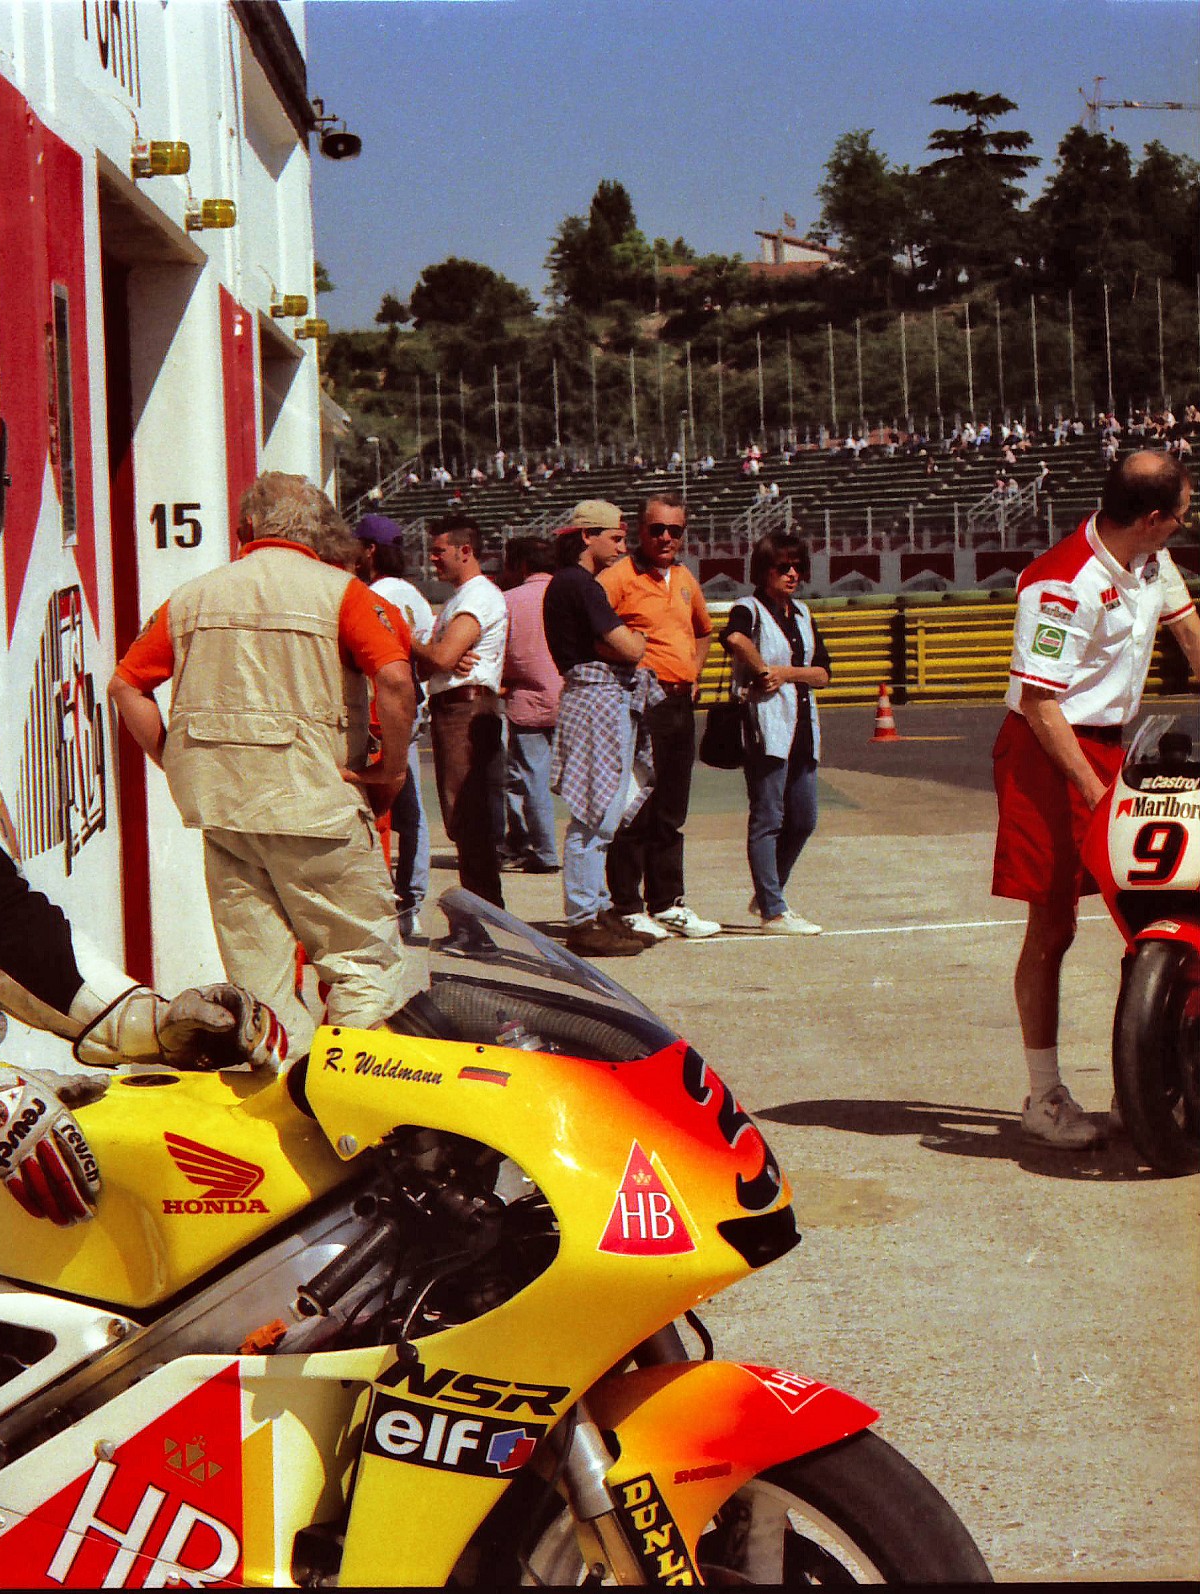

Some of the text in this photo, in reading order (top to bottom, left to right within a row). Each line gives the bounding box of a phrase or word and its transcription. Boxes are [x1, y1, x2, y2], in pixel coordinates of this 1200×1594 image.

[149, 503, 202, 549] 15
[1132, 796, 1200, 819] Marlbor
[1127, 821, 1189, 886] 9
[323, 1047, 443, 1085] R. Waldmann
[61, 1124, 99, 1183] reusch
[162, 1200, 270, 1214] HONDA
[619, 1191, 675, 1239] HB
[375, 1360, 571, 1416] NSR
[375, 1410, 483, 1466] elf
[46, 1459, 240, 1588] HB
